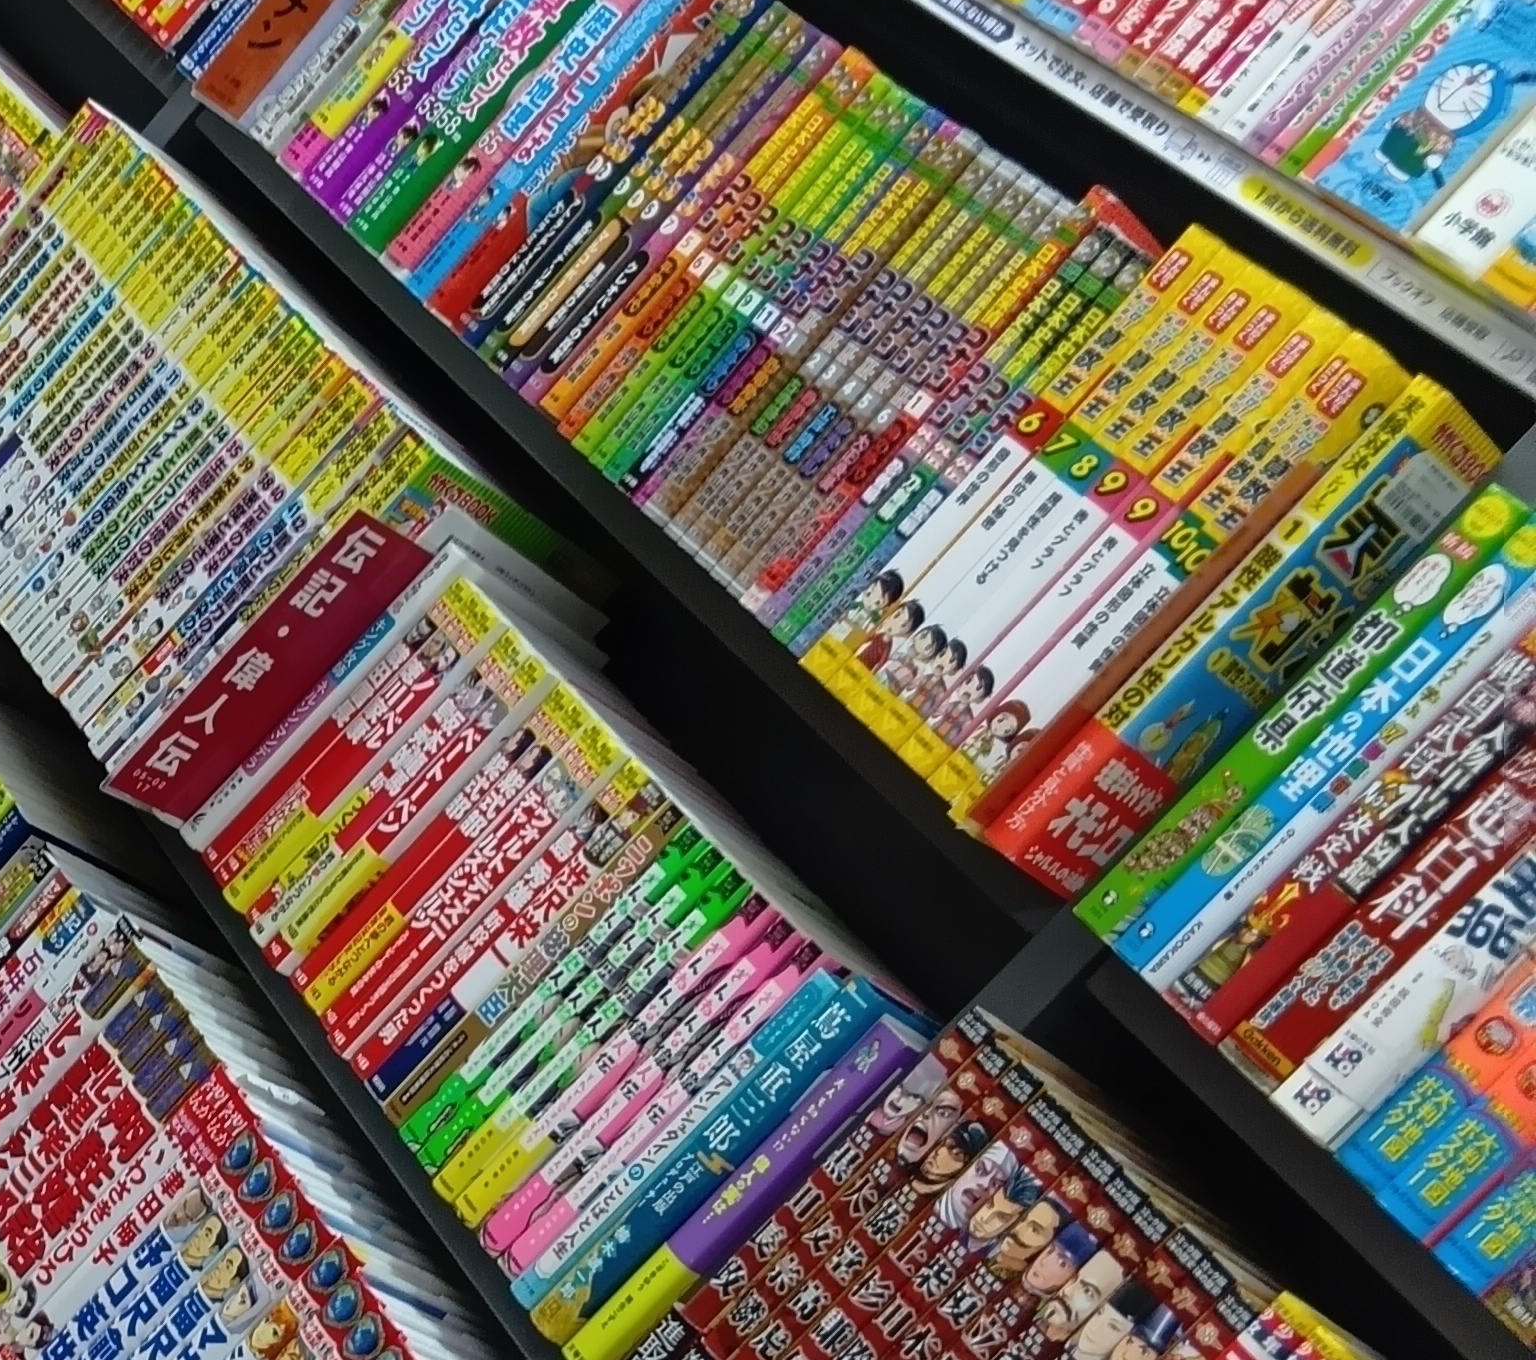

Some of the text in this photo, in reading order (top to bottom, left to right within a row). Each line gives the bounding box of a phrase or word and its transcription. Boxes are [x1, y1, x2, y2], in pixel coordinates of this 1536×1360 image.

[141, 518, 390, 785] 伝記・偉人伝
[1250, 605, 1398, 761] 都道府県
